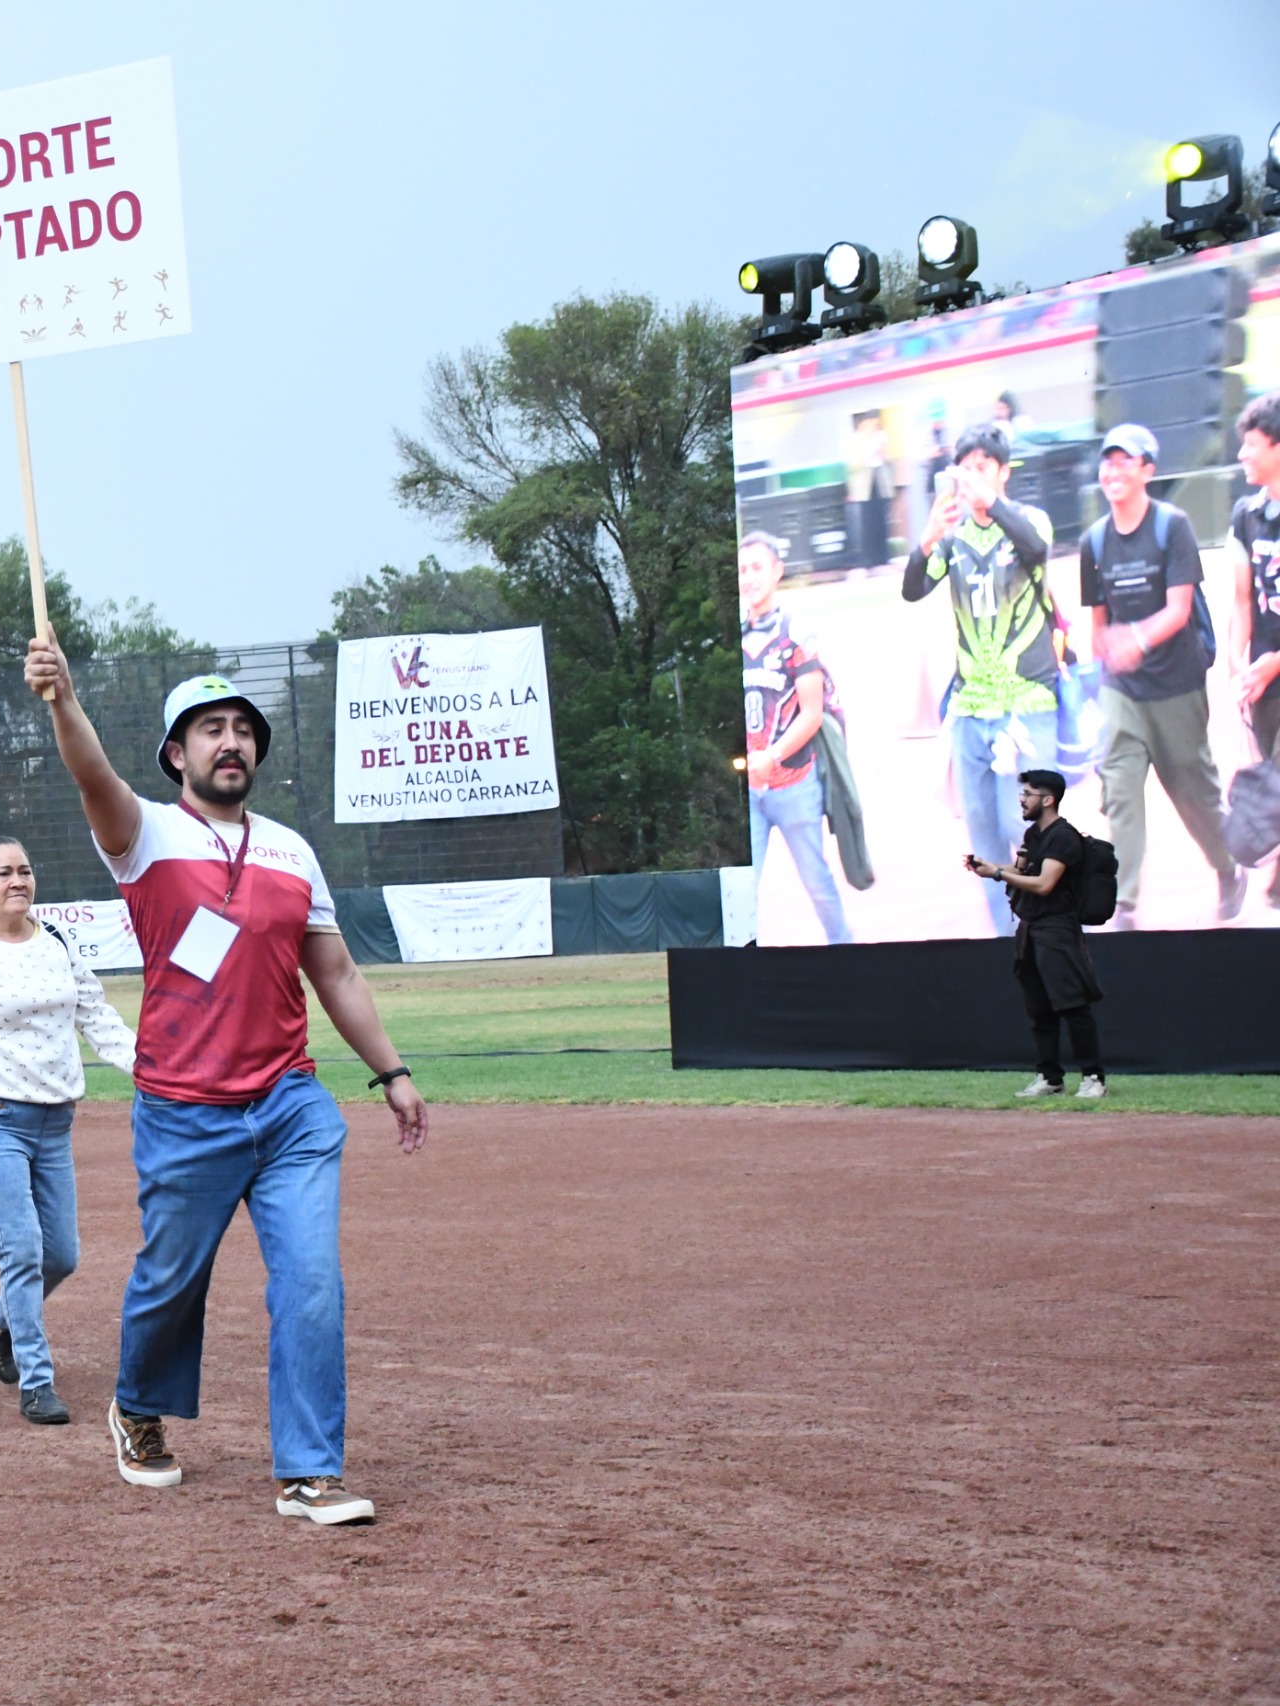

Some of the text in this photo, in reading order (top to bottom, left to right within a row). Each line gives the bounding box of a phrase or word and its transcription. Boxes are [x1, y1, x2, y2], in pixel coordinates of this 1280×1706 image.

[349, 686, 538, 719] BIENVENIDOS A LA
[407, 720, 473, 742] CUNA
[361, 736, 530, 769] DEL DEPORTE
[405, 766, 482, 786] ALCALDÍA
[348, 779, 554, 808] VENUSTIANO CARRANZA
